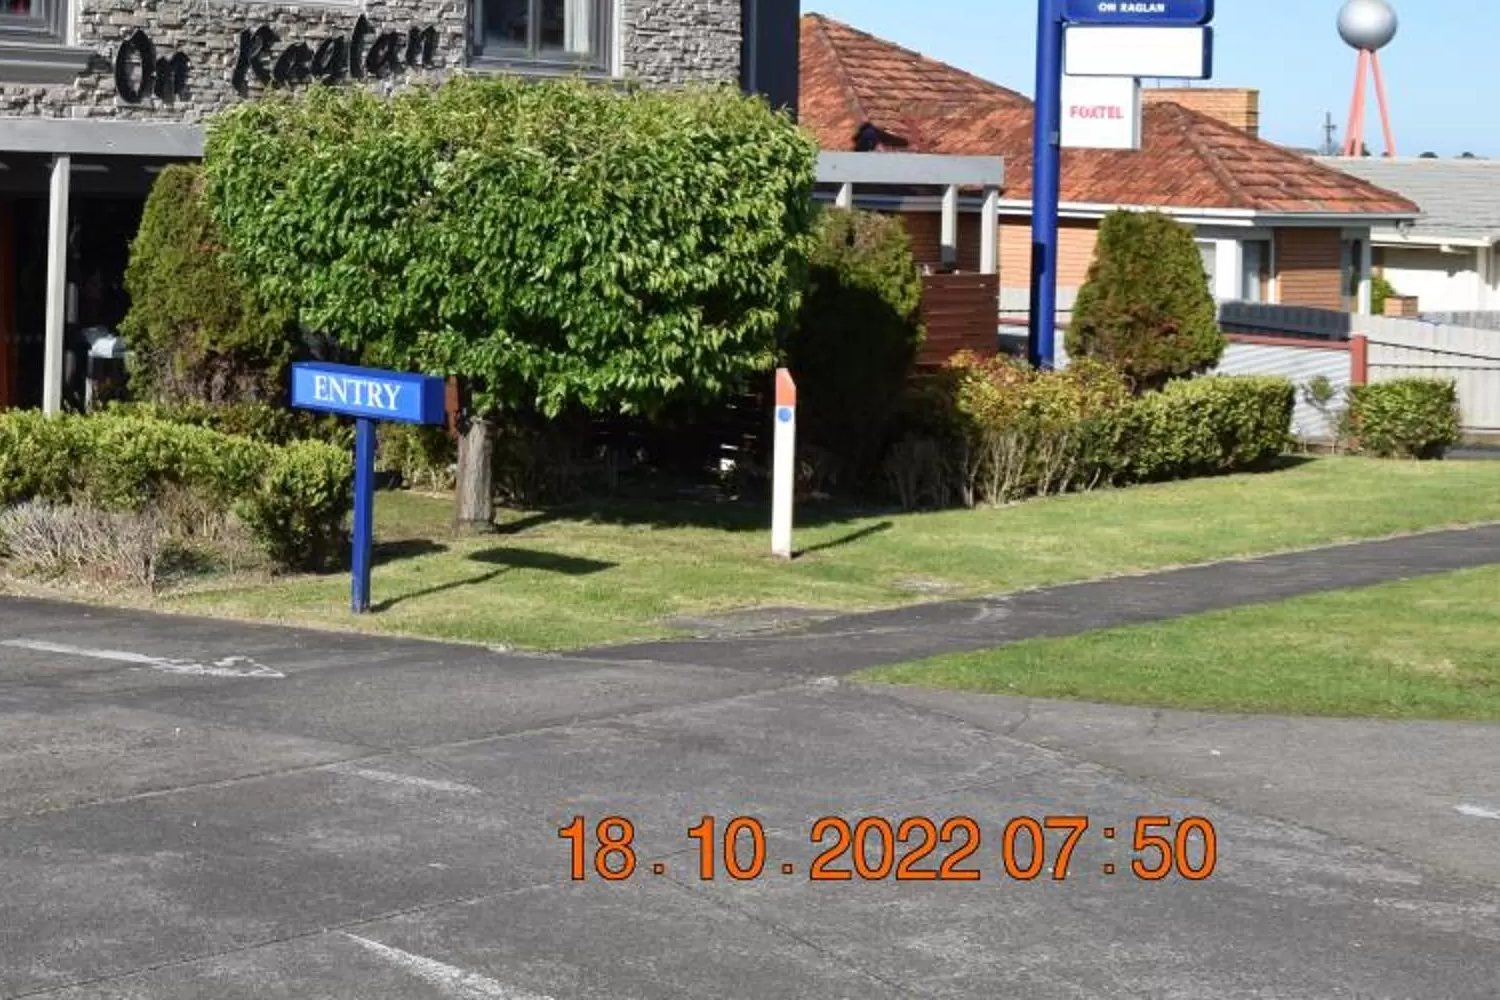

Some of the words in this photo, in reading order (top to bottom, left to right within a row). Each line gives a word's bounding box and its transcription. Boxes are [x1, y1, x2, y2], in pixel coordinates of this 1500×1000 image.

[1098, 2, 1117, 13] ON
[1119, 2, 1166, 13] RAGLAN
[114, 27, 192, 103] On
[1069, 105, 1125, 120] FOXTEL
[314, 375, 401, 411] ENTRY
